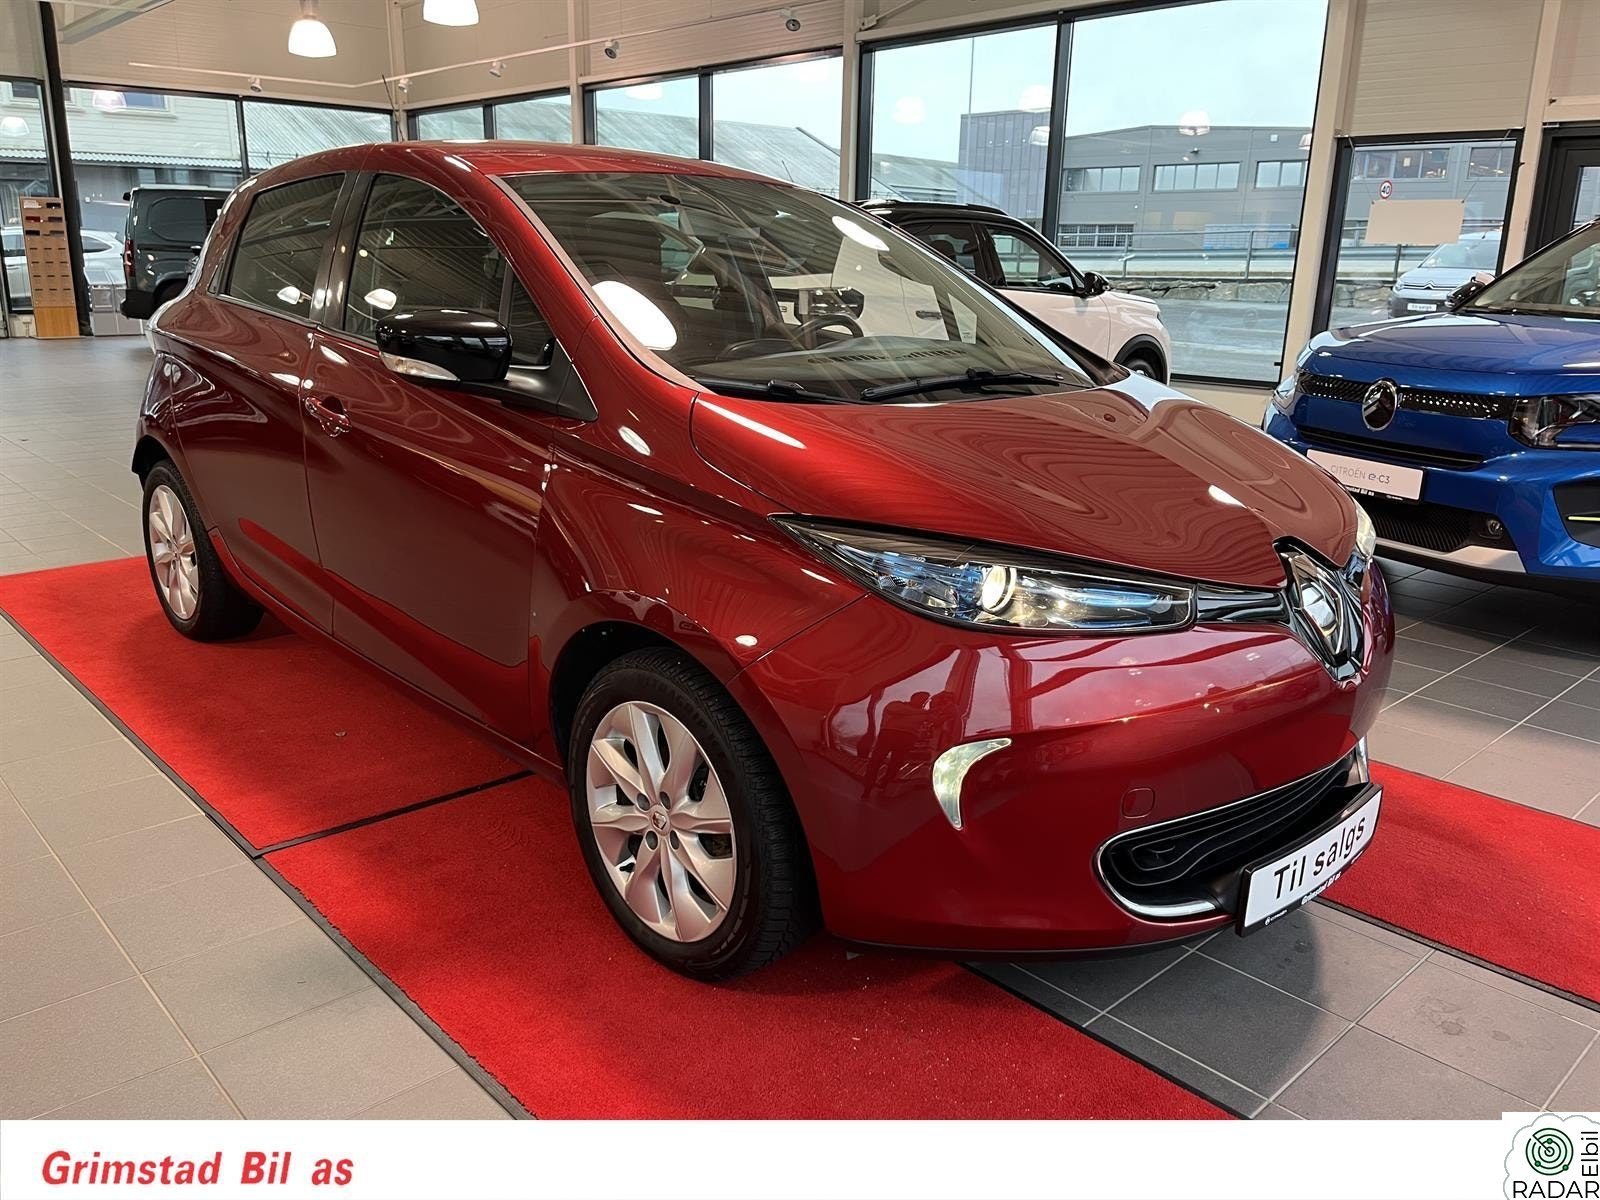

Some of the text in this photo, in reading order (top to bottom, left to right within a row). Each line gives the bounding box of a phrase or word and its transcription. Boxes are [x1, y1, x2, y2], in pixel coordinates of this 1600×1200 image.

[1381, 184, 1391, 195] 40
[1274, 816, 1366, 900] Til salgs
